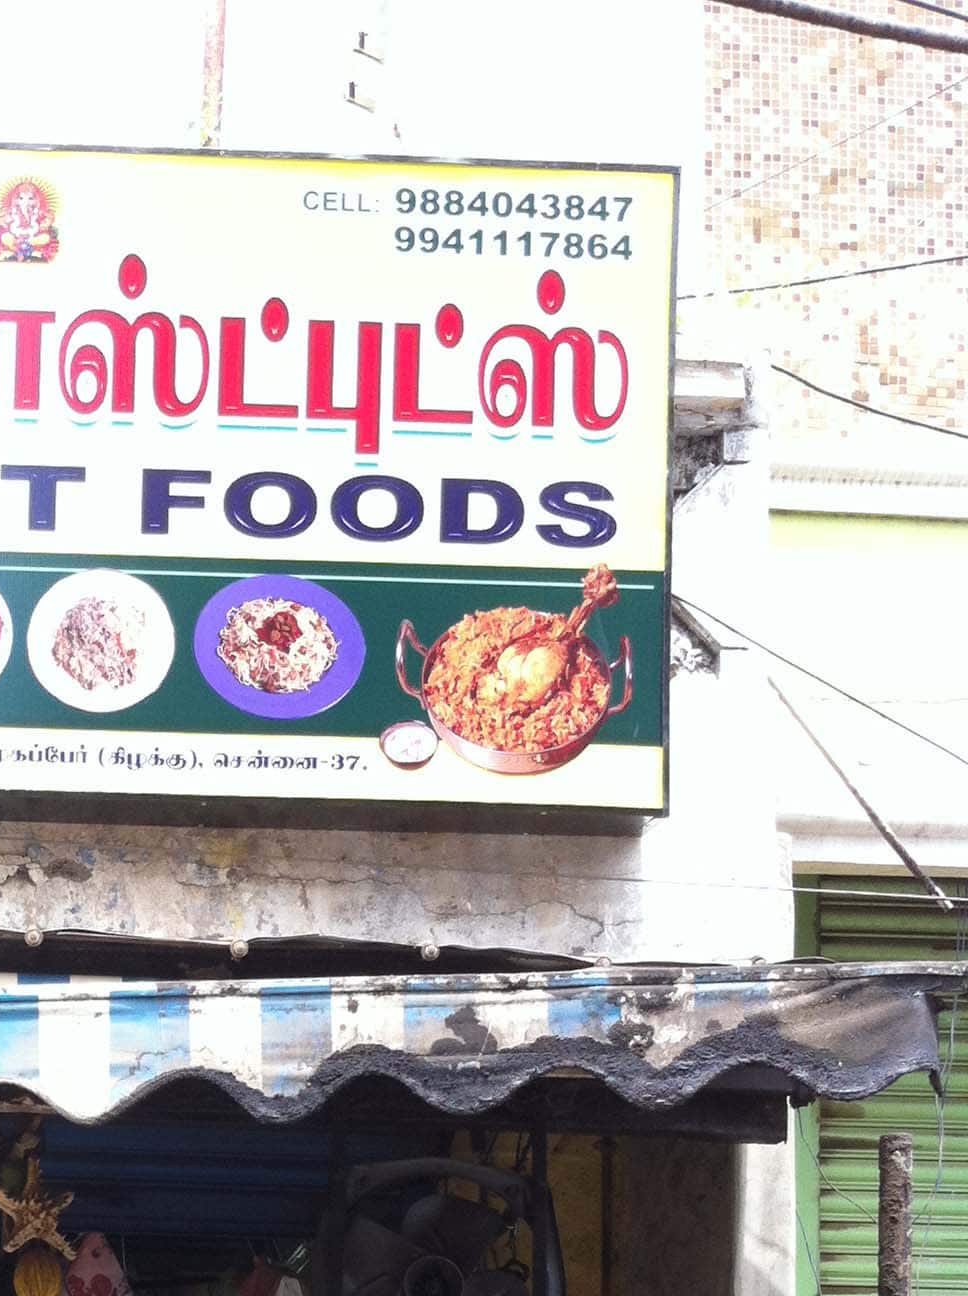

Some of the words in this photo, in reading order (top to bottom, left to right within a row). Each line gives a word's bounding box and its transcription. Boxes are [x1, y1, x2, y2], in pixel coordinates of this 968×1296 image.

[303, 190, 381, 214] CELL:
[395, 188, 634, 223] 9884043847
[394, 226, 634, 261] 9941117864
[141, 467, 619, 549] FOODS
